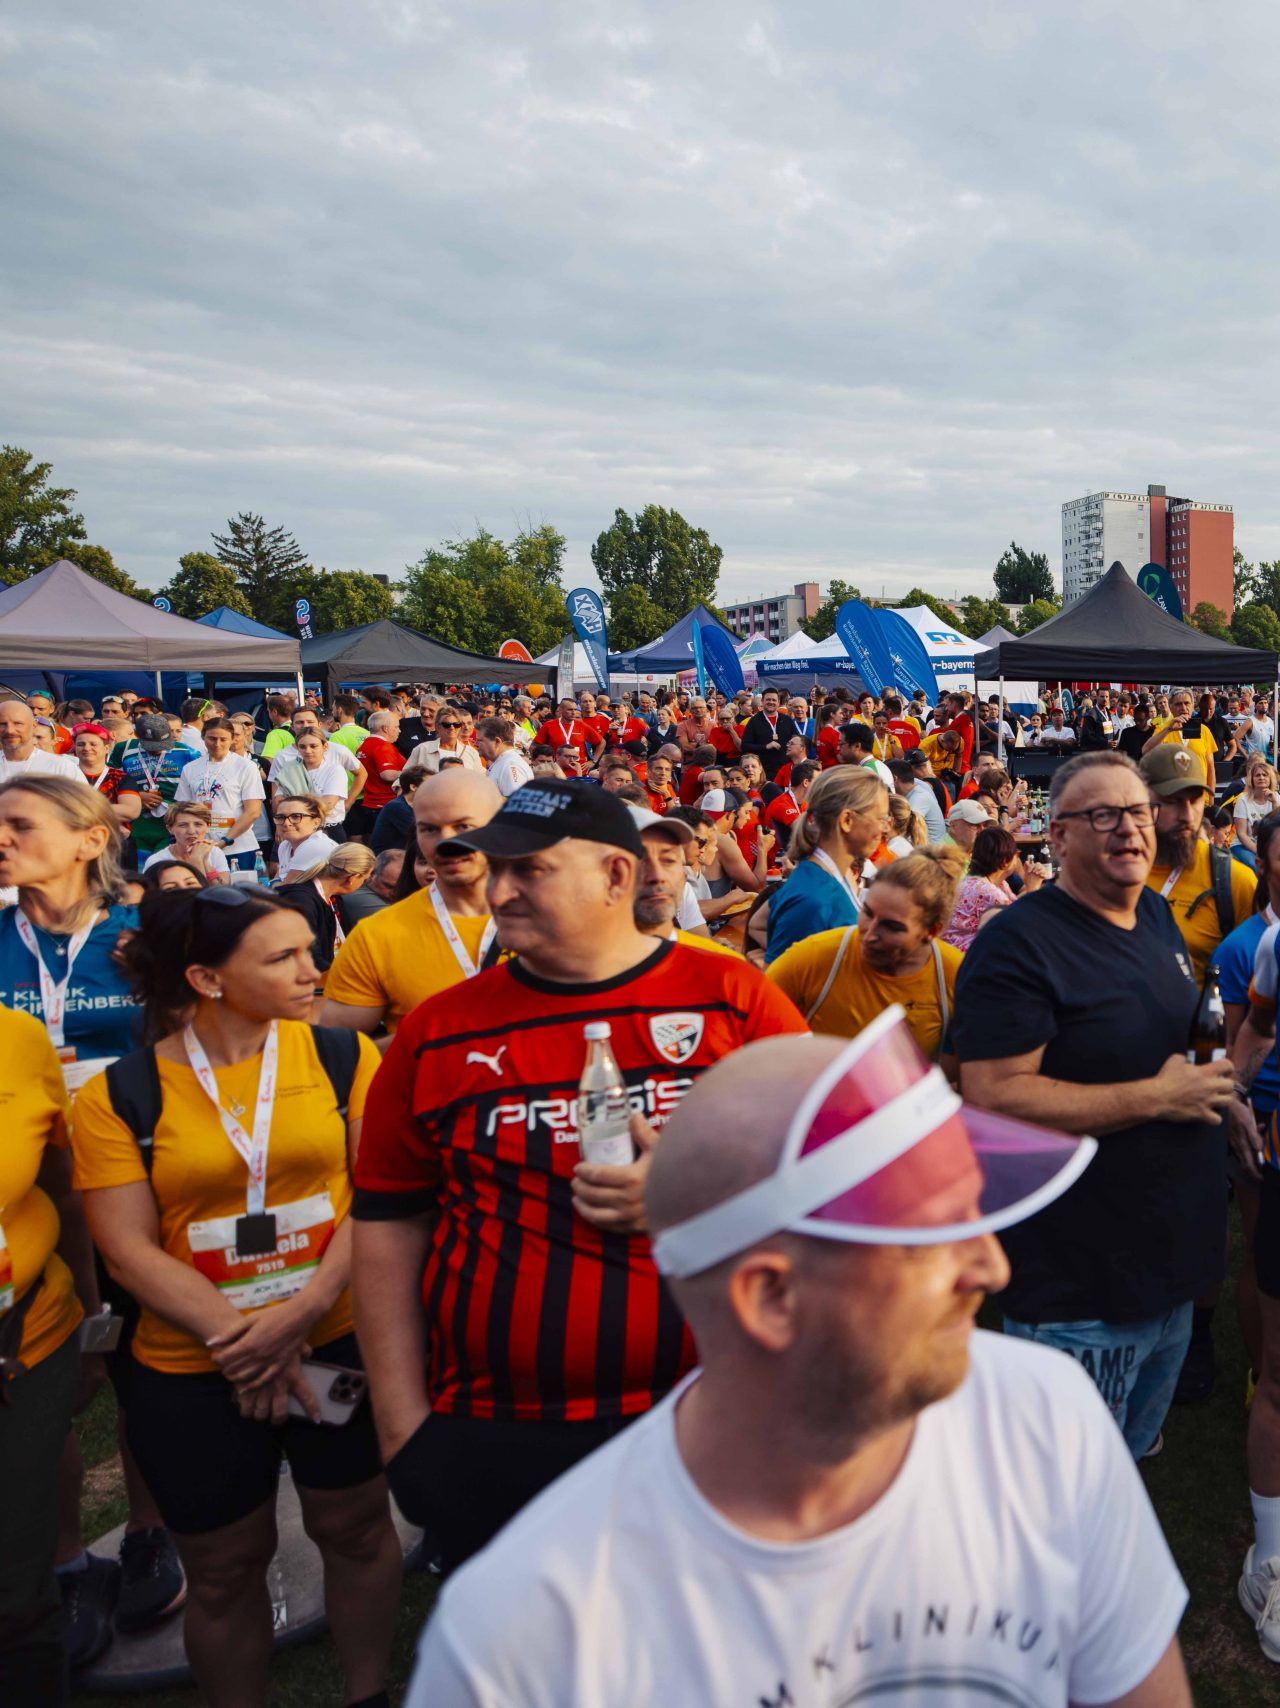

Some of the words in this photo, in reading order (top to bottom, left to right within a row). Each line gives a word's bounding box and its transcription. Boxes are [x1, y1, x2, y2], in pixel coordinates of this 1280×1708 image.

[14, 987, 86, 1001] KLIK
[224, 1232, 310, 1267] Dela
[811, 1603, 1062, 1683] KLINIKU
